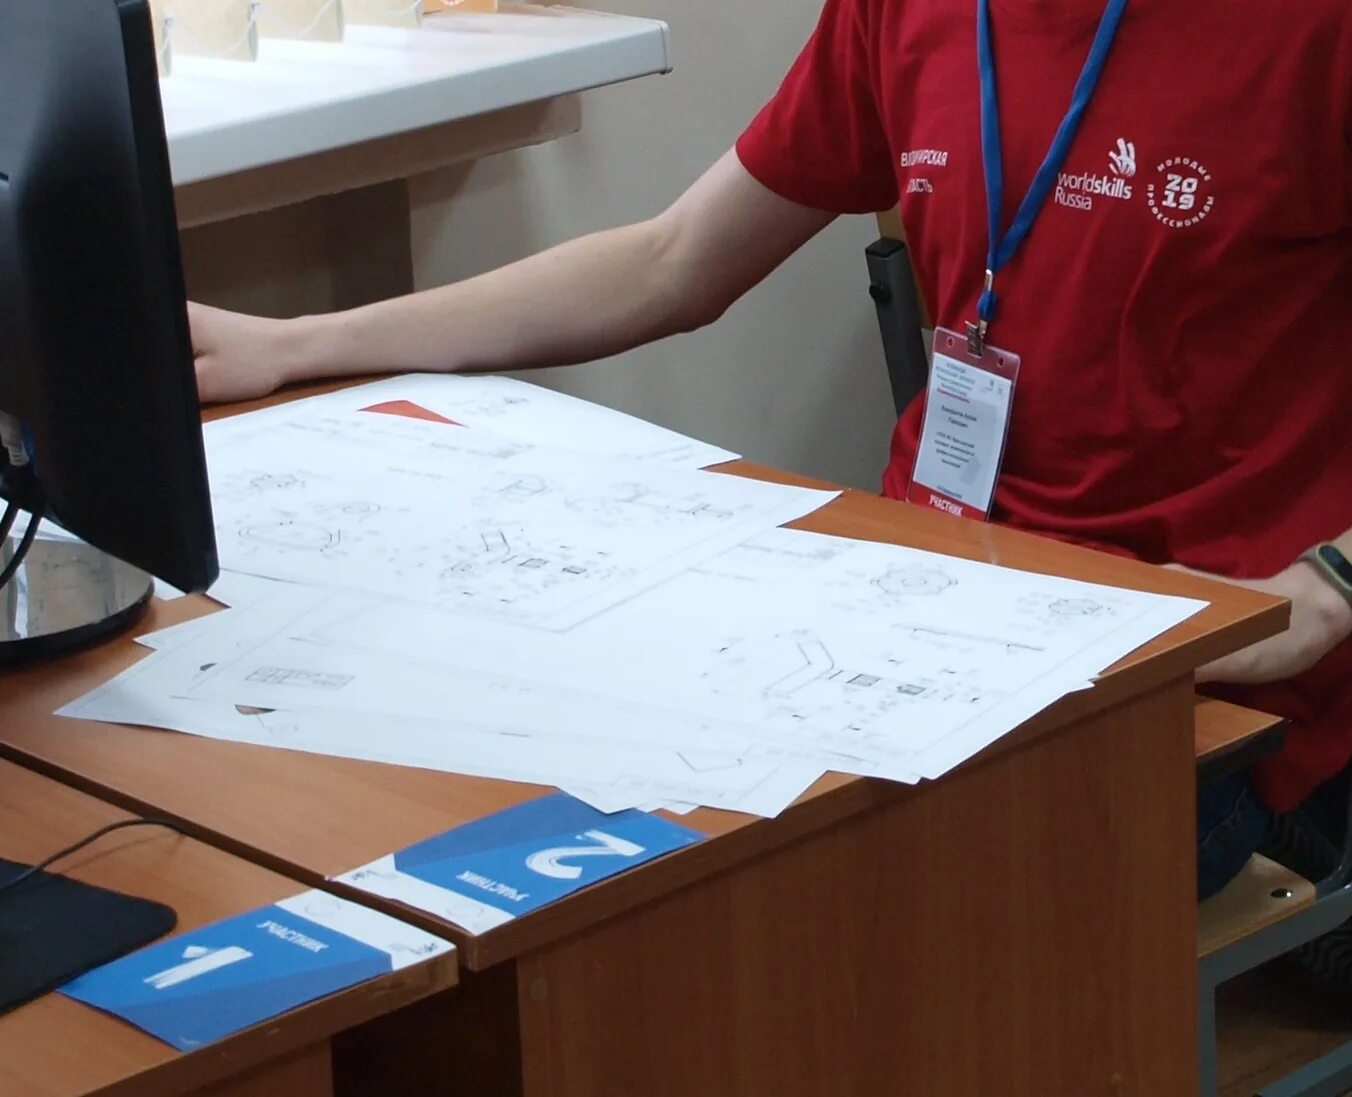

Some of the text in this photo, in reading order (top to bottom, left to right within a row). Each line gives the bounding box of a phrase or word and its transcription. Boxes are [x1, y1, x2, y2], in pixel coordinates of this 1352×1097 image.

[1054, 185, 1093, 211] Russia
[1057, 172, 1133, 200] worldskills
[1165, 173, 1199, 194] 20
[1161, 190, 1196, 211] 19
[525, 829, 647, 880] 2
[455, 869, 530, 902] УЧАСТНИК
[256, 919, 330, 953] УЧАСТНИК
[143, 945, 254, 990] 1
